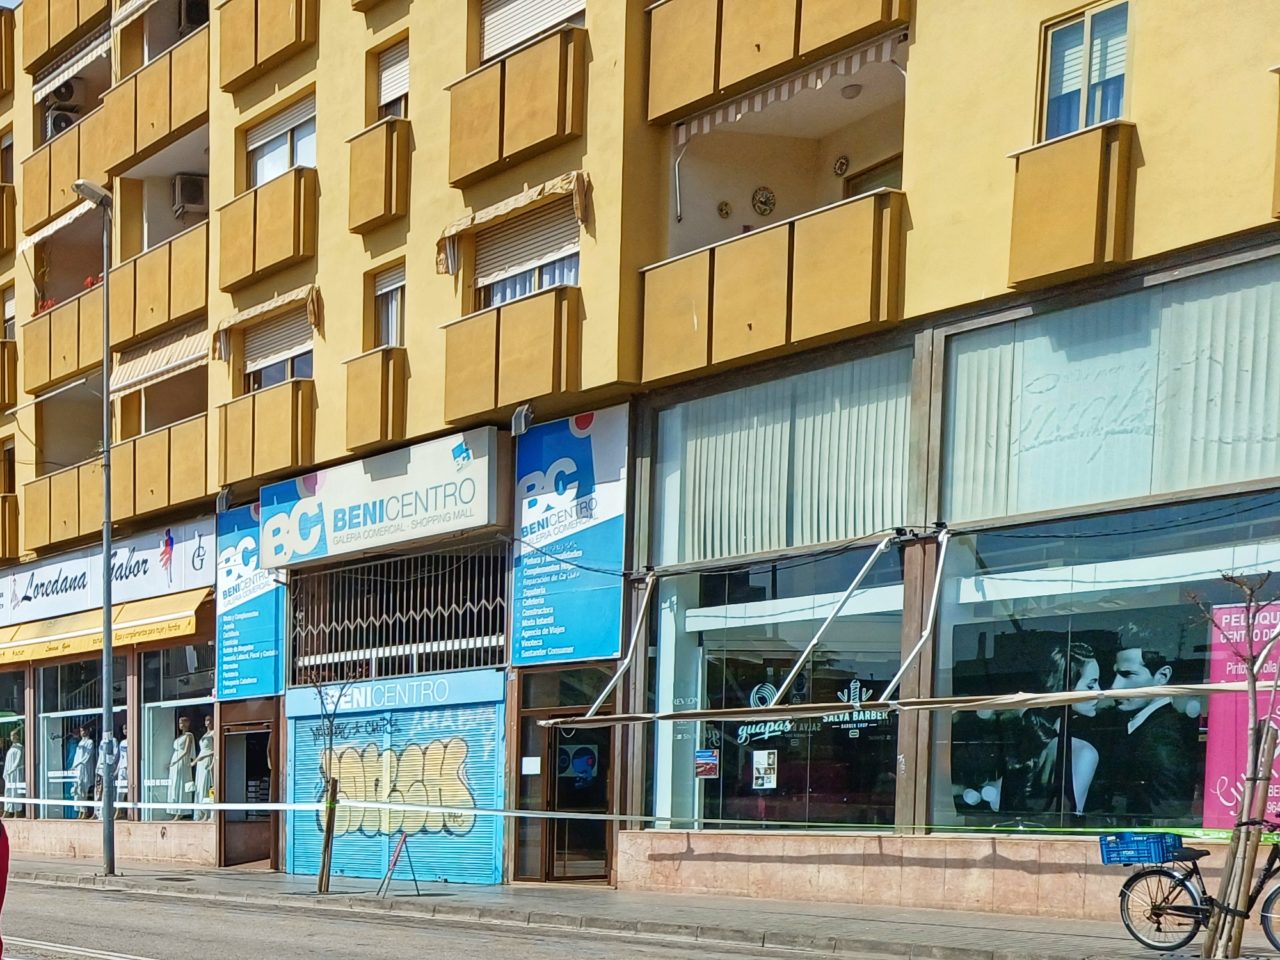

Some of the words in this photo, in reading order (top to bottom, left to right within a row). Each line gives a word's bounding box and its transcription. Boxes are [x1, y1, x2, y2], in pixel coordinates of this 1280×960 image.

[333, 478, 476, 533] BENICENTRO
[521, 498, 598, 538] BENICENTRO
[333, 533, 362, 545] GALERIA
[363, 524, 405, 539] COMERCIAL
[411, 514, 451, 530] SHOPPING
[453, 509, 474, 520] MALL
[21, 567, 88, 602] Loredana
[522, 629, 541, 638] Agencia
[549, 626, 566, 635] Viajes
[521, 649, 547, 657] Santander
[548, 646, 575, 655] Consumer
[326, 679, 449, 709] BENICENTRO
[822, 712, 850, 722] SALVA
[853, 710, 889, 721] BARBER
[737, 720, 794, 745] guapas
